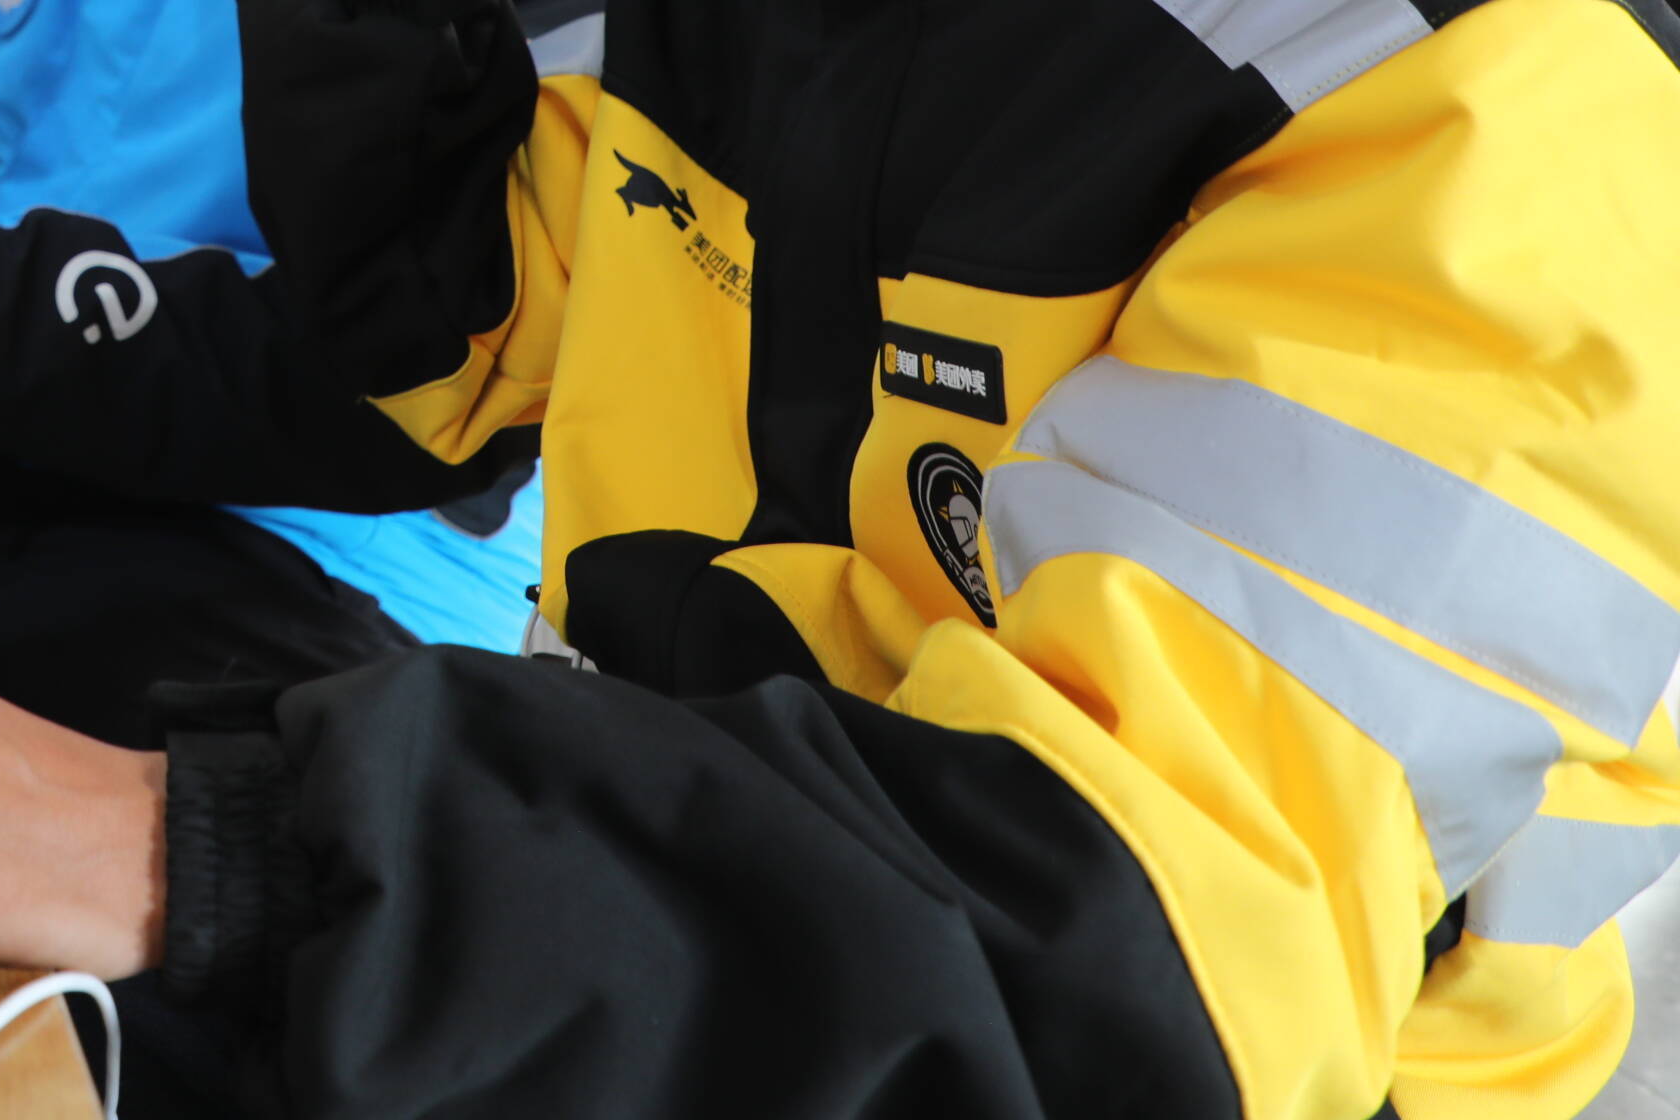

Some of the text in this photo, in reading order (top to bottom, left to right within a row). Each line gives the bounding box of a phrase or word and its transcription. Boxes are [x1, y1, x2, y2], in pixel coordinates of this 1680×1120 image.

[896, 349, 918, 379] 美团
[935, 360, 986, 397] 美团外卖
